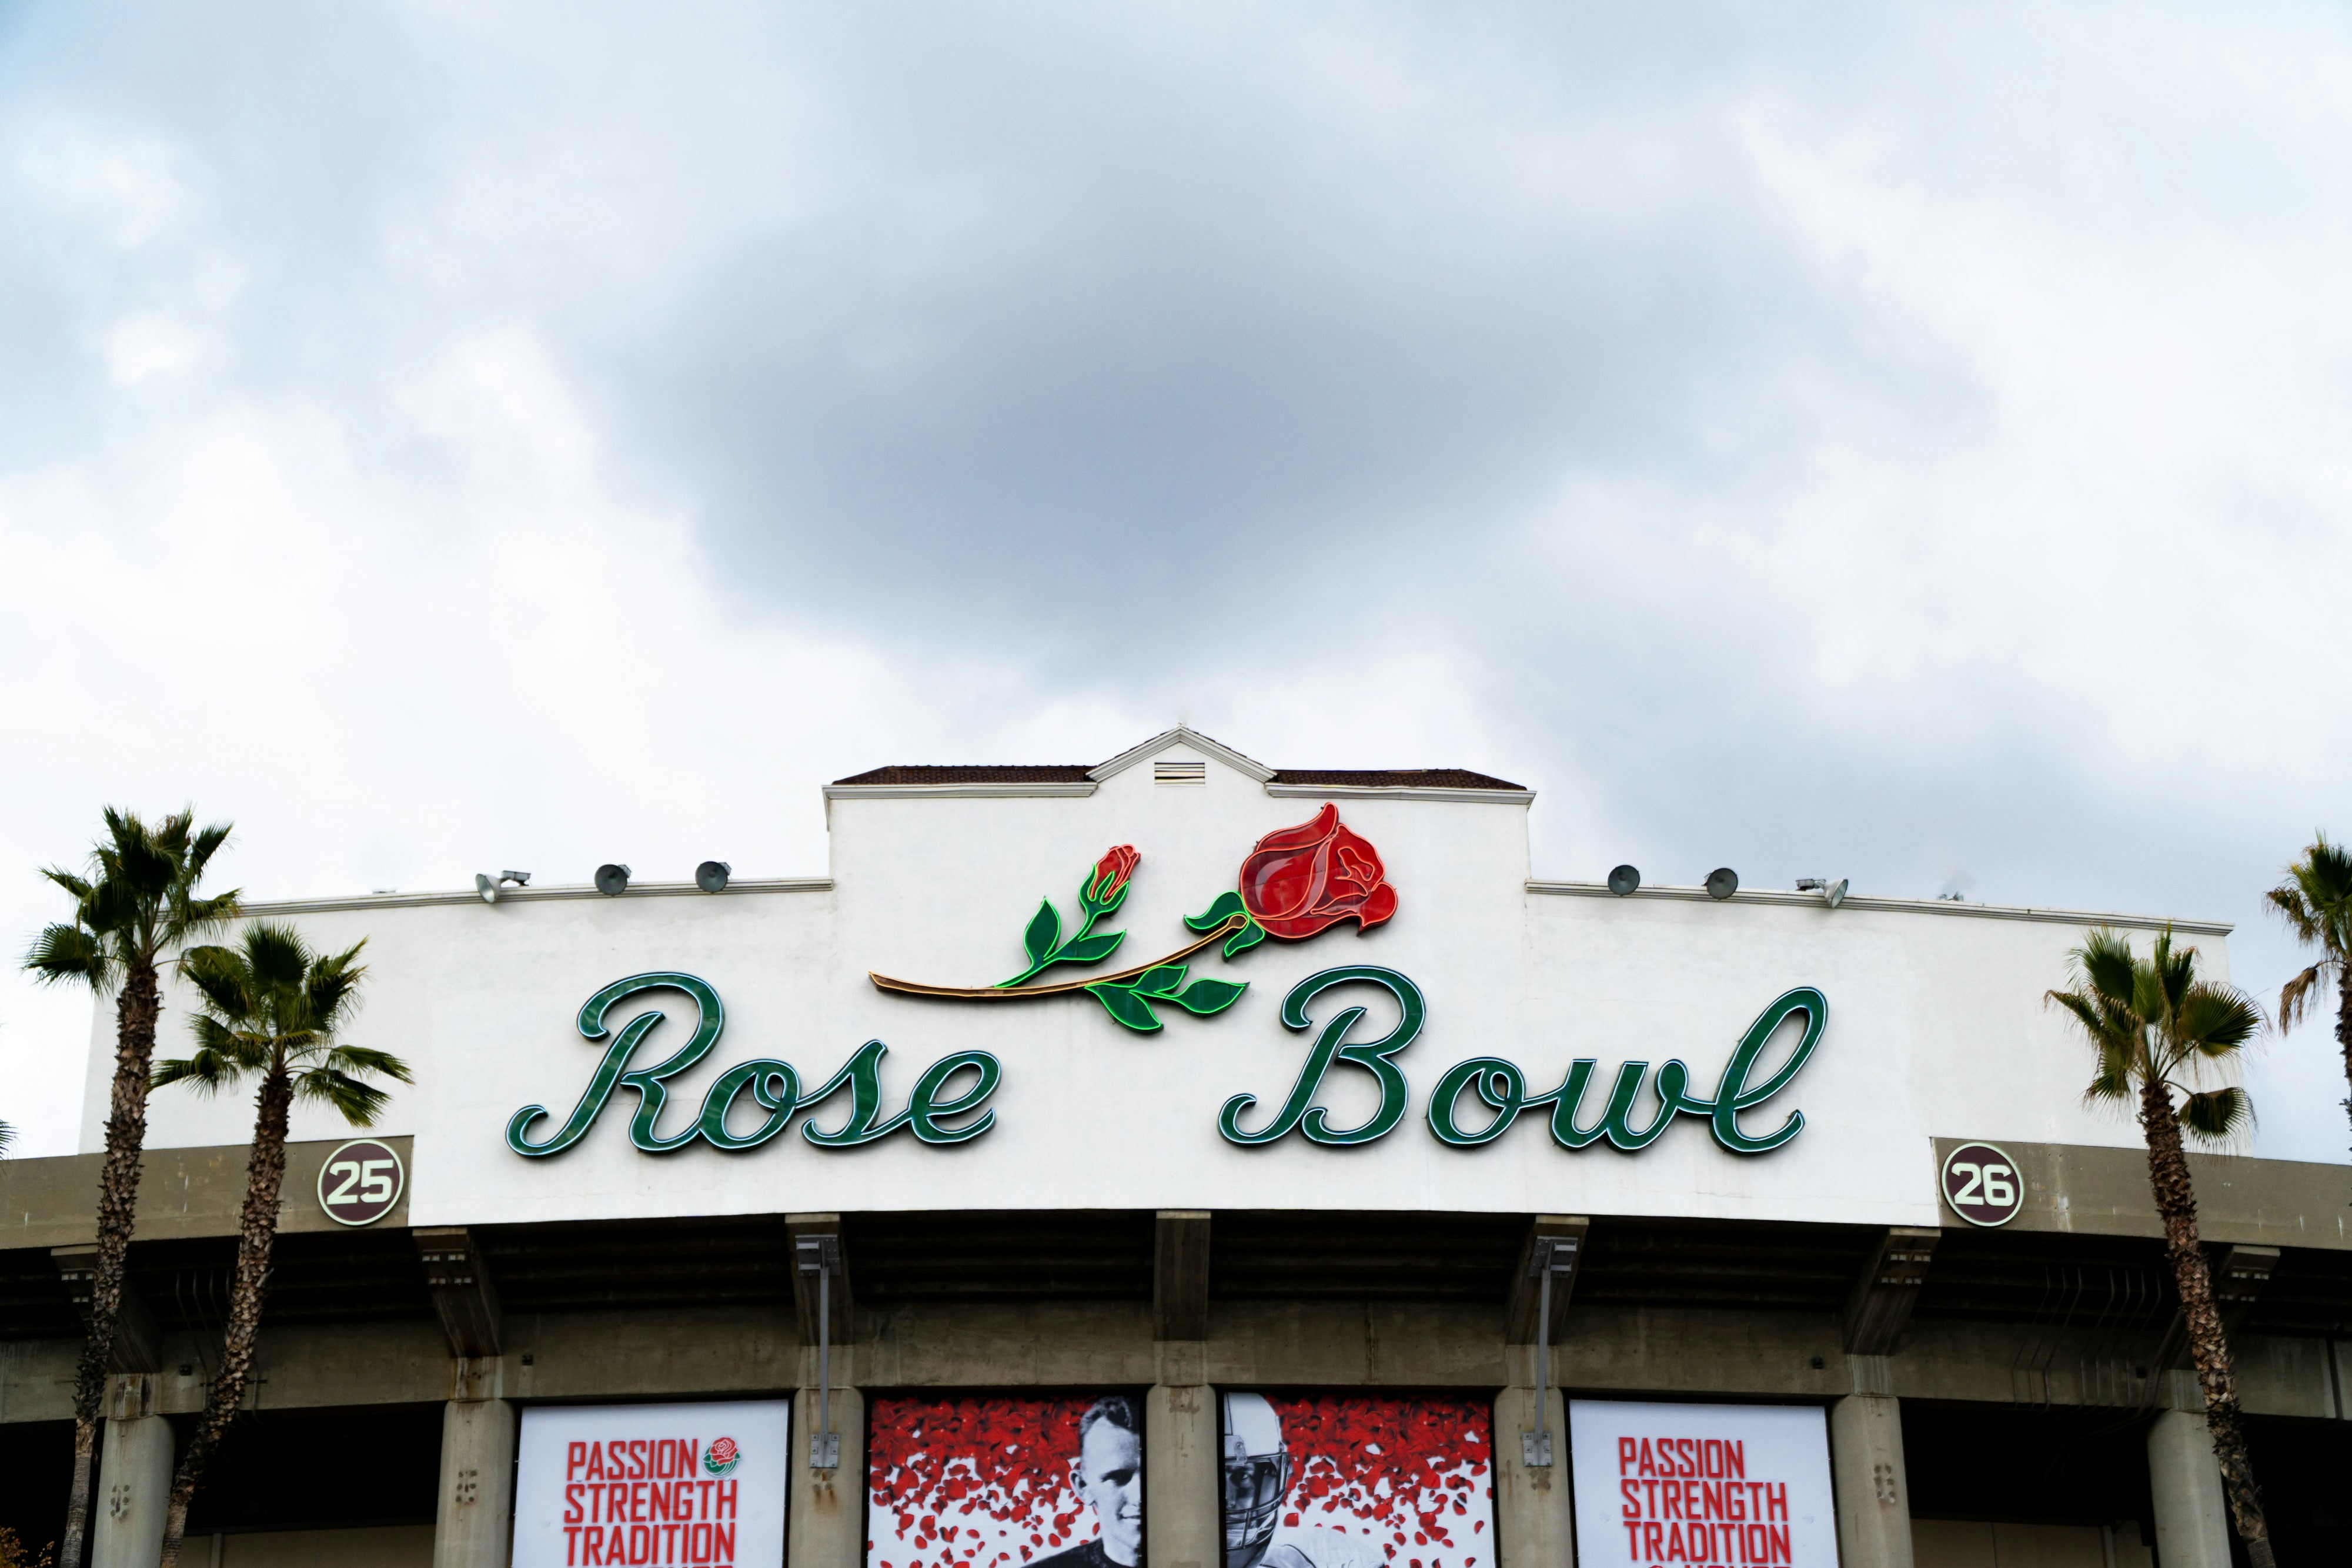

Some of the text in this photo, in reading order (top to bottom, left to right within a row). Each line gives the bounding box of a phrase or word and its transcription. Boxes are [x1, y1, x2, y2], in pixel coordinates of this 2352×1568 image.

[506, 965, 1828, 1158] Rose Bowl
[326, 1159, 395, 1205] 25
[1951, 1162, 2015, 1207] 26
[567, 1439, 698, 1482] PASSION
[1618, 1437, 1745, 1479] PASSION
[564, 1479, 737, 1524] STRENGTH
[1620, 1478, 1788, 1522] STRENGTH
[563, 1522, 736, 1567] TRADITION
[1623, 1520, 1792, 1564] TRADITION
